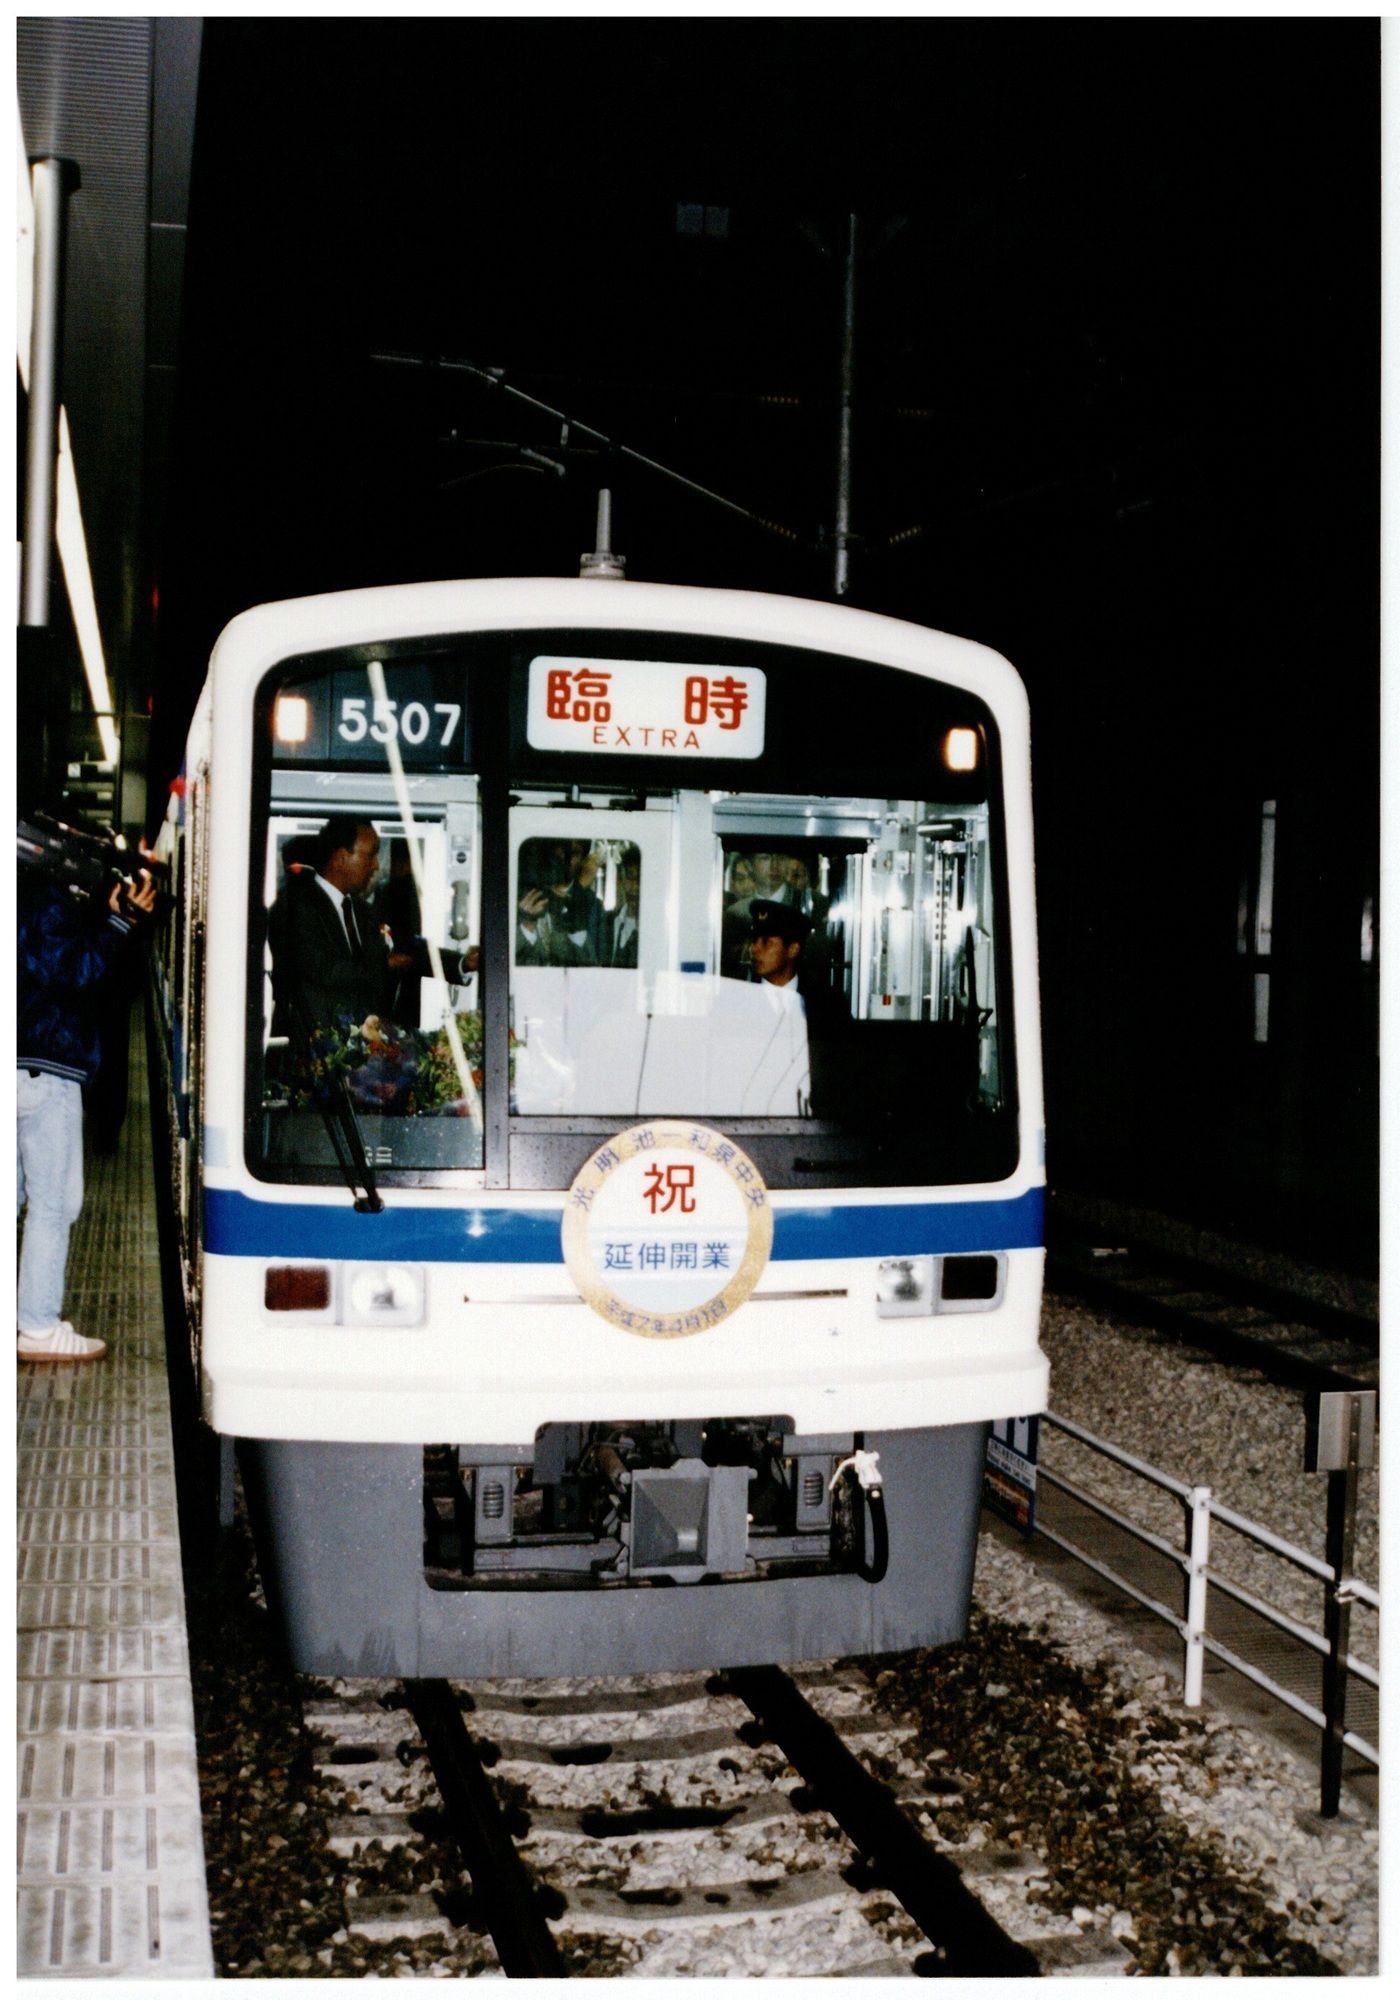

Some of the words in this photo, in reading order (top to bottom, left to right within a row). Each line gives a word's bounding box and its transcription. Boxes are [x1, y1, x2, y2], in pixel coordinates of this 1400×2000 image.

[546, 668, 748, 729] 臨時
[338, 699, 461, 747] 5507
[592, 725, 701, 750] EXTRA
[642, 1163, 697, 1215] 祝
[604, 1241, 731, 1271] 延伸開業
